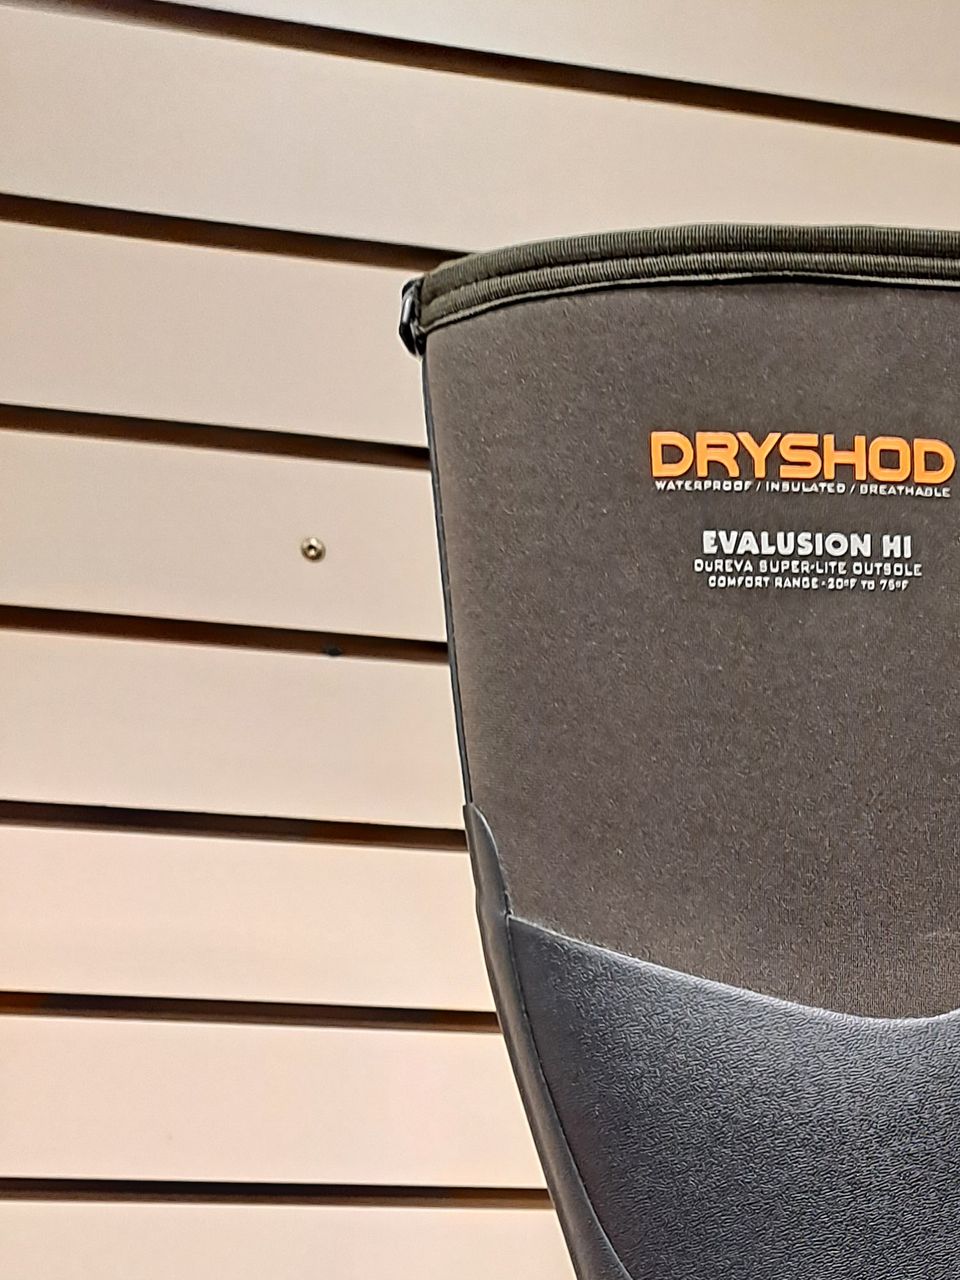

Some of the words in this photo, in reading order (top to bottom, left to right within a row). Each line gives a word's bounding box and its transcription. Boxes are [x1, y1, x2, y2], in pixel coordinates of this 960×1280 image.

[650, 431, 956, 484] DRYSHOD
[655, 480, 752, 491] WATERPROOF
[766, 481, 846, 494] INSULATED
[860, 484, 950, 499] BREATHABLE
[702, 530, 871, 557] EVALUSION
[882, 534, 912, 559] HI
[694, 559, 753, 573] DUREVA
[853, 562, 922, 577] OUTSOLE
[708, 575, 770, 588] COMFORT
[775, 577, 818, 589] RANGE
[861, 580, 875, 590] TO
